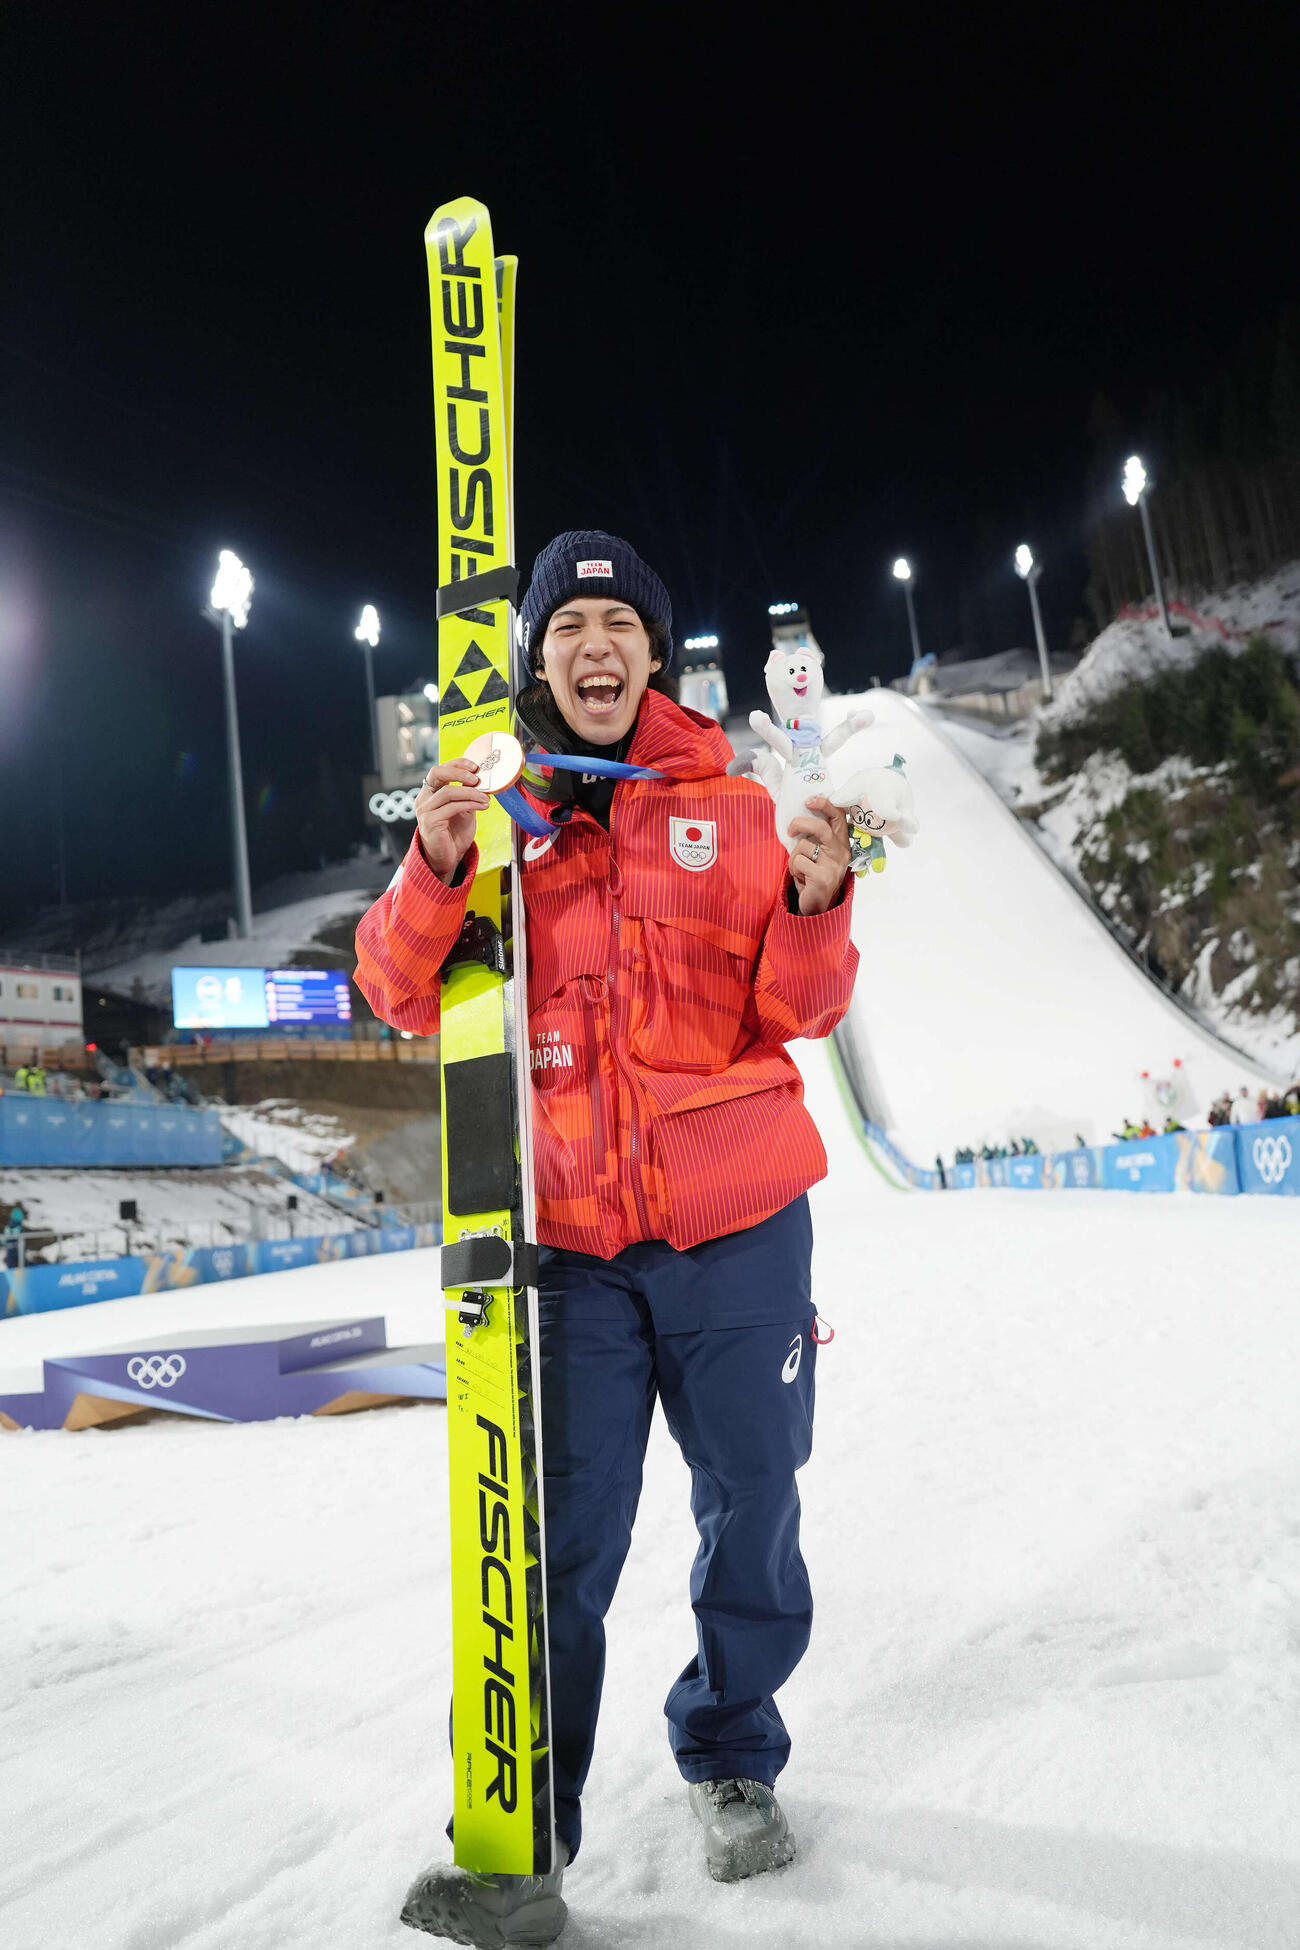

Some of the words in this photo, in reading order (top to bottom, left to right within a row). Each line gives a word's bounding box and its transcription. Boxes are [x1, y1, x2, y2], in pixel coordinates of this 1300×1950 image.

[437, 217, 495, 627] FISCHER
[581, 567, 610, 575] JAPAN
[442, 706, 506, 729] FISCHER
[536, 1030, 560, 1044] TEAM
[529, 1044, 573, 1070] JAPAN
[476, 1414, 517, 1814] FISCHER
